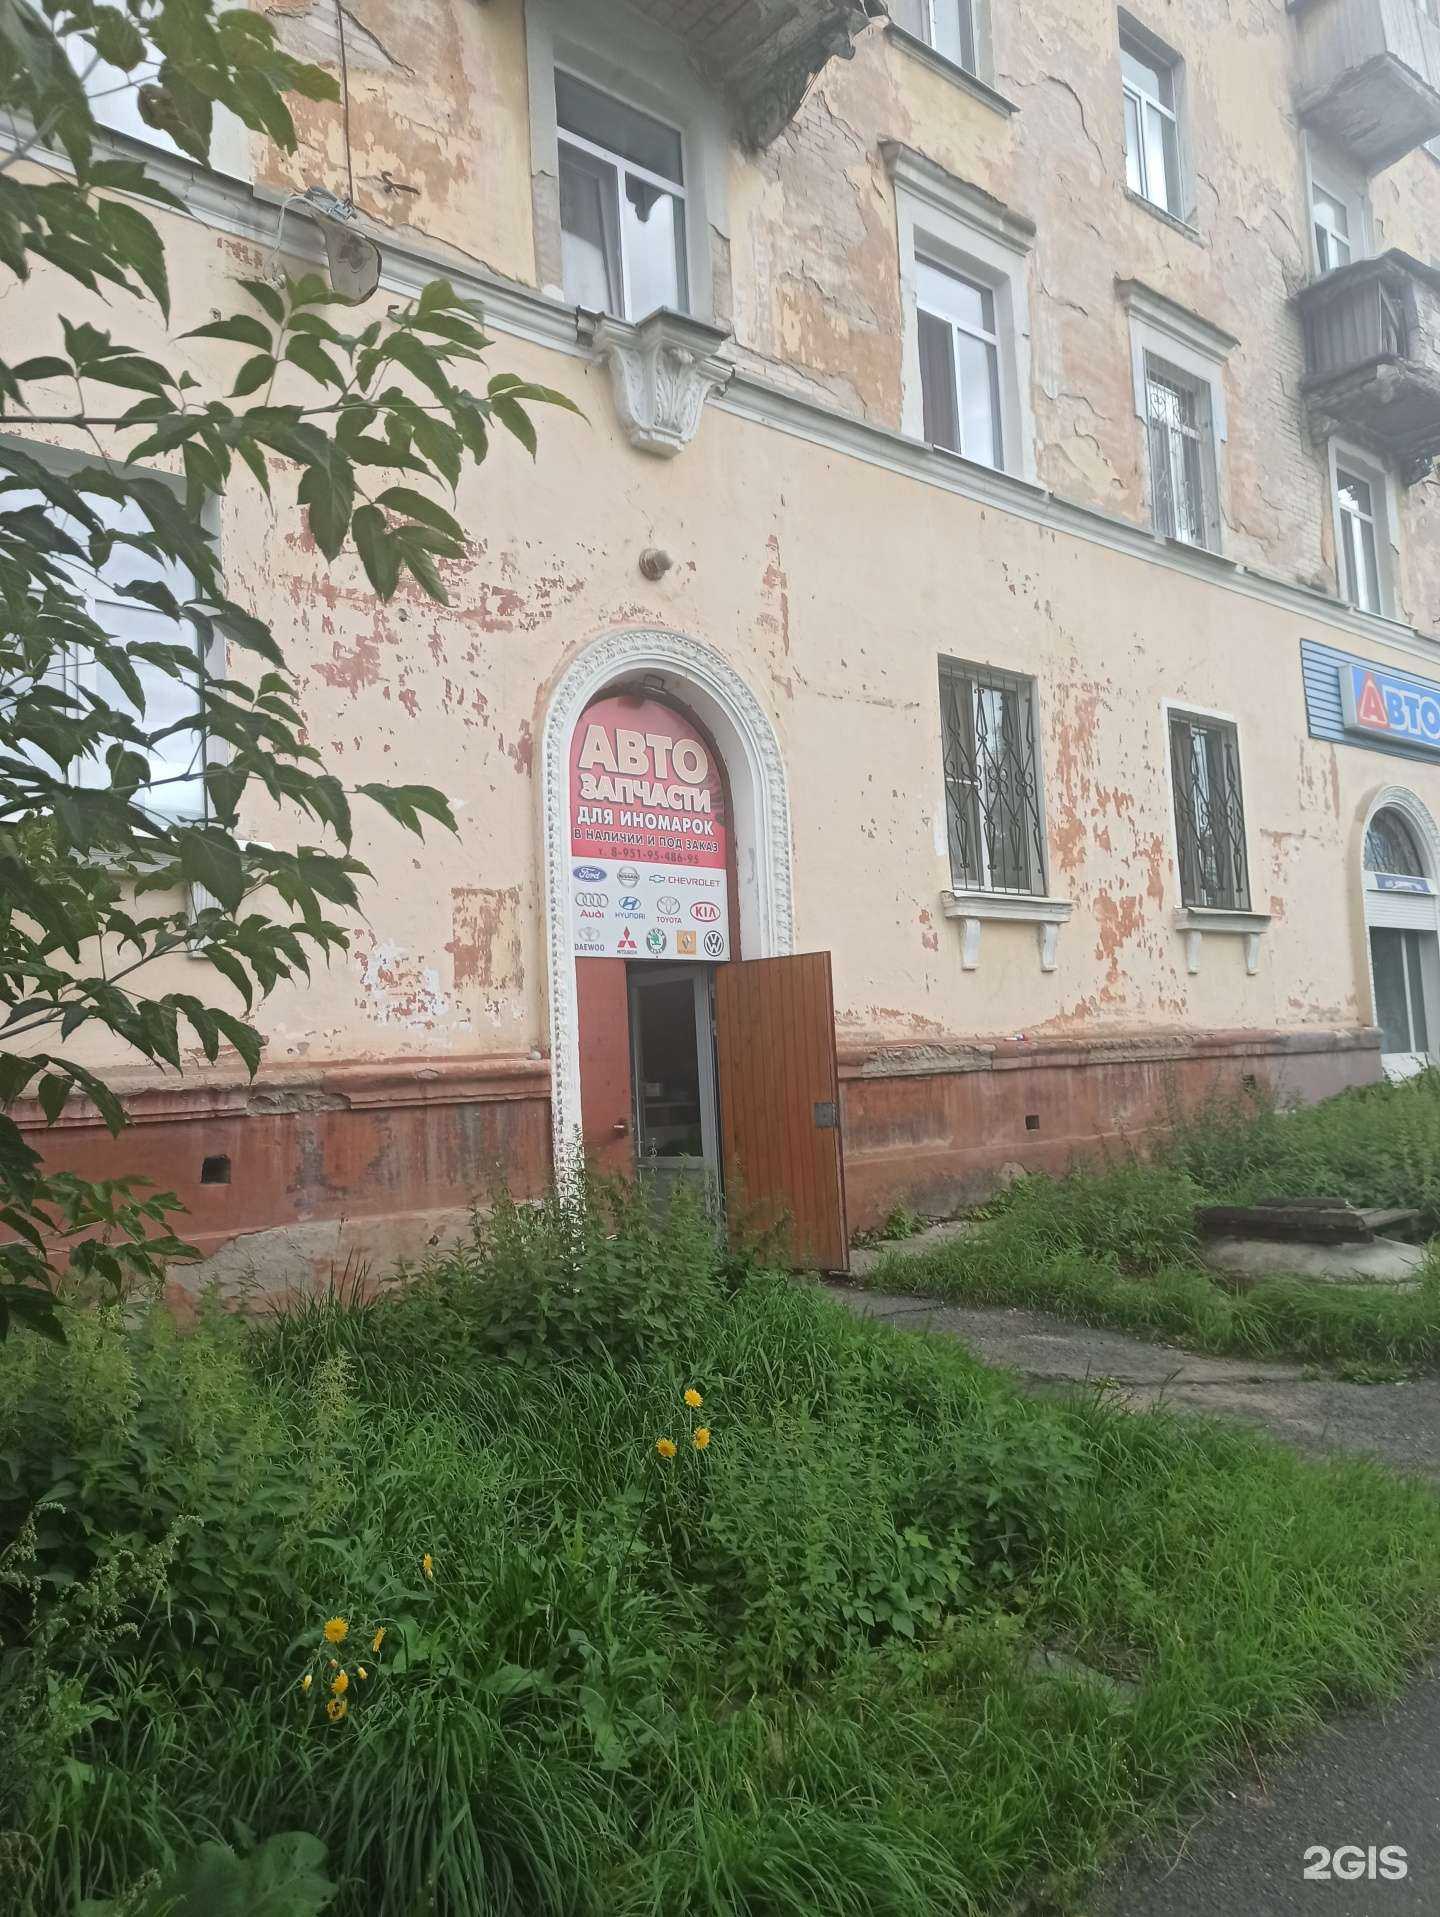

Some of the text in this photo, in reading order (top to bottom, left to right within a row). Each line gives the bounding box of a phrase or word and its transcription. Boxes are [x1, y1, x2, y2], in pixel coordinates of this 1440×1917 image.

[578, 724, 708, 784] АВТО
[580, 773, 711, 813] ЗАПЧАСТИ
[577, 806, 714, 835] ДЛЯ ИНОМАРОК
[574, 829, 719, 852] В НАЛИЧИИ И ПОД ЗАКАЗ
[578, 867, 601, 880] Ford
[668, 876, 721, 887] CHEVROLET
[580, 909, 605, 918] Audi
[695, 908, 717, 918] KIA
[656, 916, 682, 924] TOYOTA
